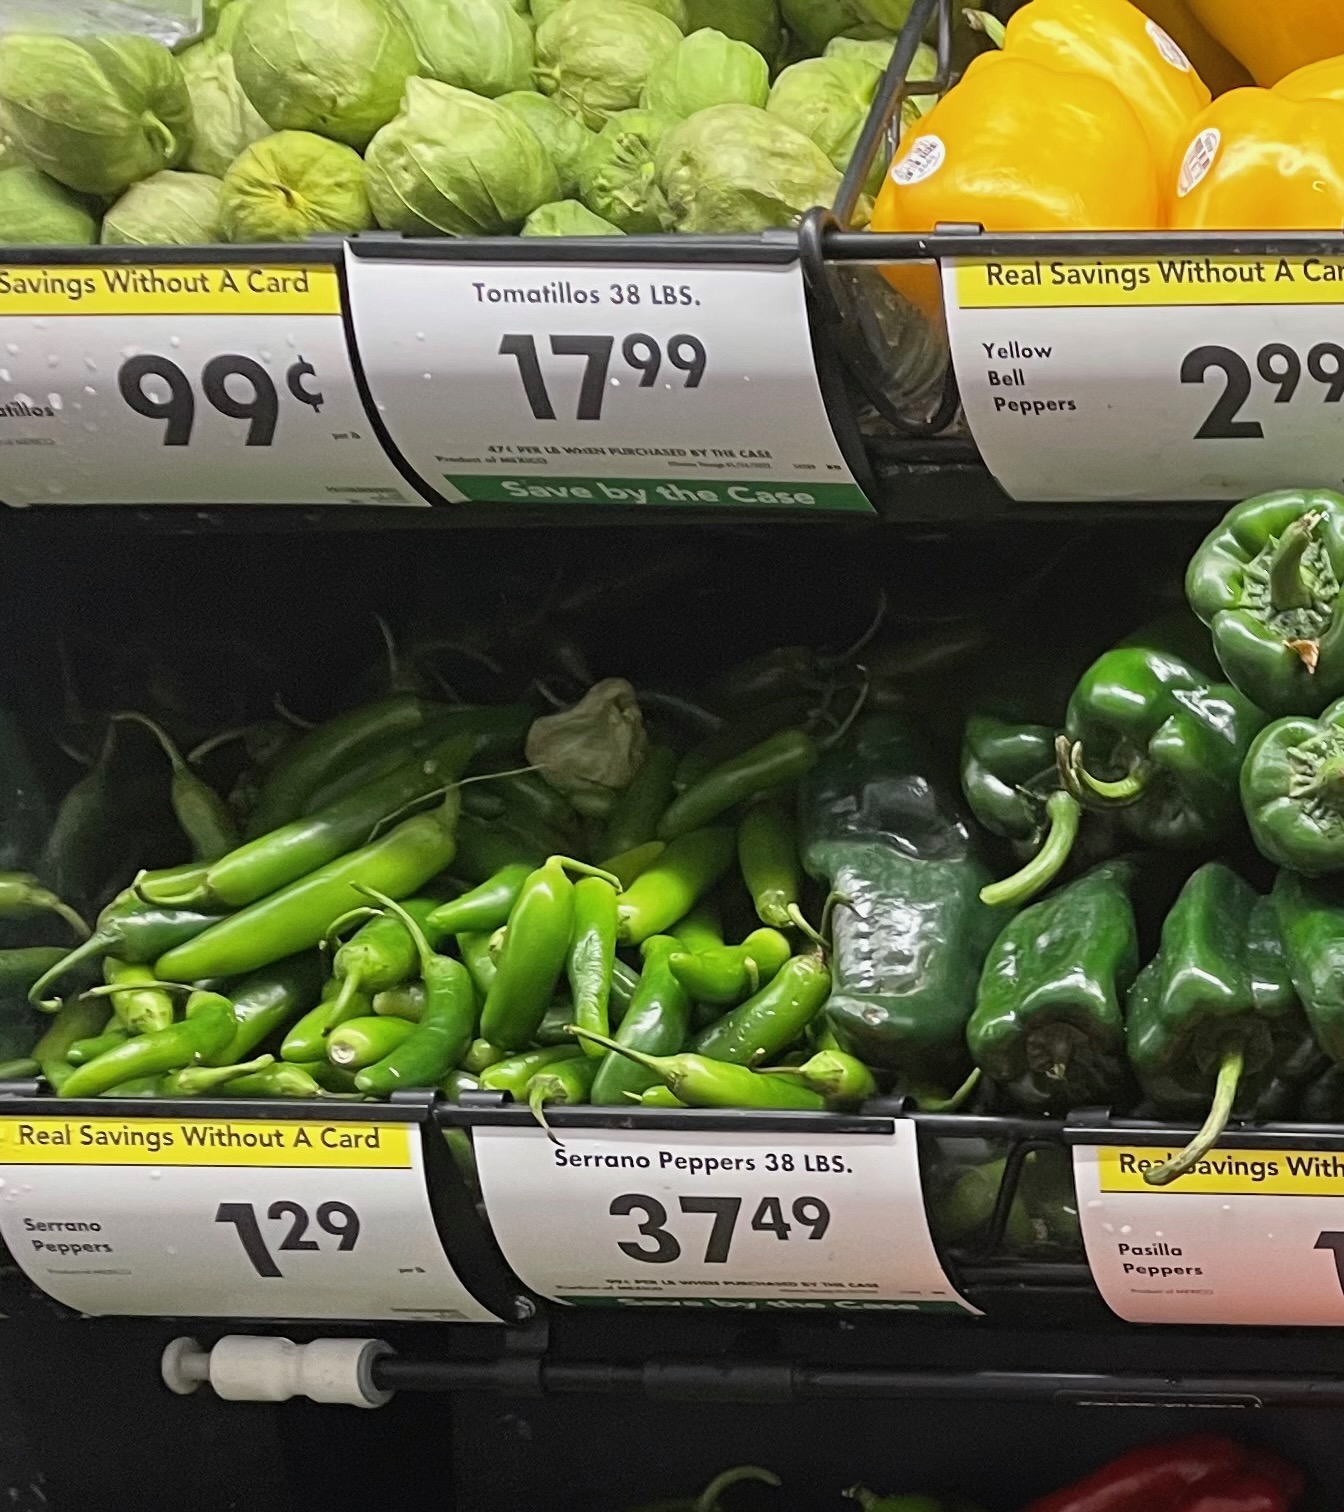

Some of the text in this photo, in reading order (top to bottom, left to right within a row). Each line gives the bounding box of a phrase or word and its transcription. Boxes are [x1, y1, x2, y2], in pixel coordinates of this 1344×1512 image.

[988, 263, 1041, 285] Real
[1052, 261, 1150, 290] Savings
[1158, 259, 1264, 283] Without
[1275, 259, 1295, 282] A
[0, 269, 309, 300] Savings Without A Card
[472, 282, 700, 305] Tomatillos 38 LBS.
[982, 341, 1051, 358] Yellow
[988, 369, 1025, 386] Bell
[118, 355, 324, 447] 99¢
[994, 397, 1076, 415] Peppers
[503, 480, 816, 505] Save by the Case
[555, 1149, 852, 1175] Serrano Peppers 38 LBS.
[24, 1218, 101, 1231] Serrano
[32, 1240, 112, 1255] Peppers
[1118, 1243, 1182, 1256] Pasilla
[1123, 1264, 1202, 1277] Peppers
